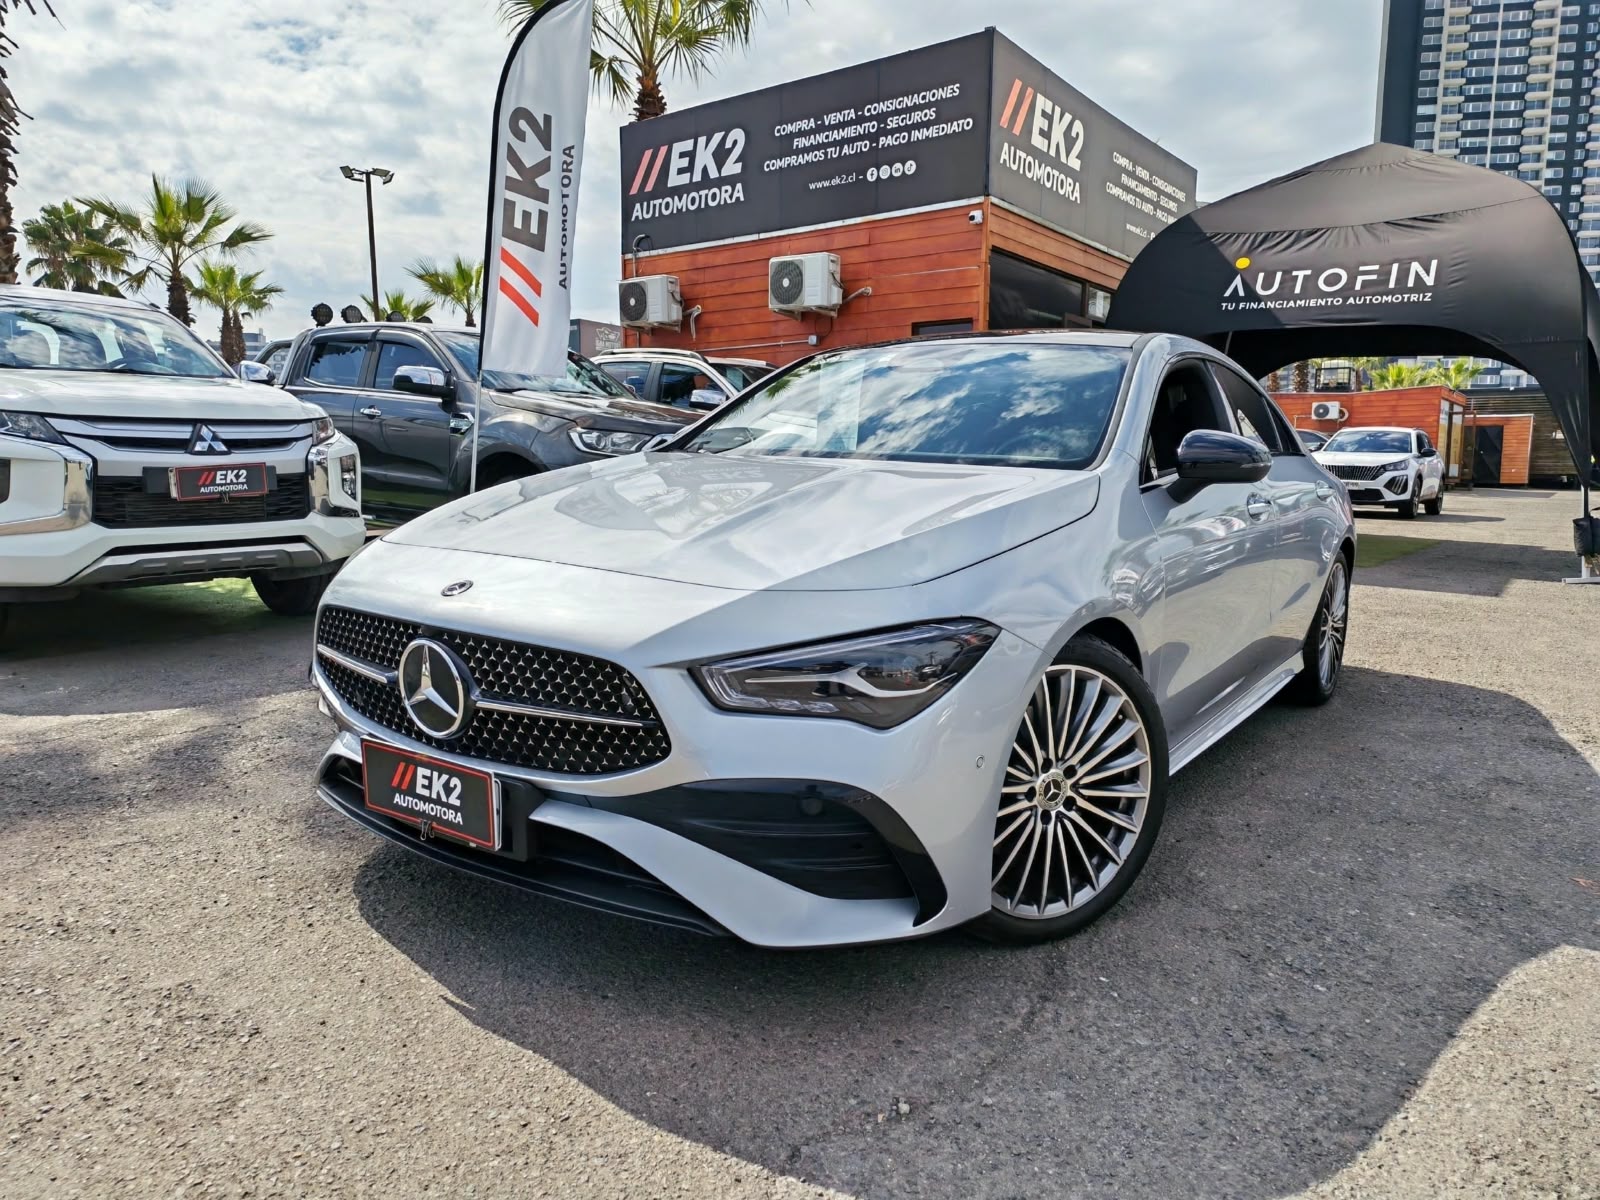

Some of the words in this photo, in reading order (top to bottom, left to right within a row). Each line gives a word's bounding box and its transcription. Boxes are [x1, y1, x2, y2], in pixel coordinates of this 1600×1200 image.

[774, 117, 816, 137] COMPRA
[824, 108, 856, 127] VENTA
[864, 83, 960, 117] CONSIGNACIONES
[793, 121, 878, 149] FINANCIAMIENTO
[886, 107, 937, 129] SEGUROS
[763, 149, 825, 172] COMPRAMOS
[826, 146, 840, 160] TU
[841, 140, 870, 157] AUTO
[878, 131, 909, 149] PAGO
[910, 117, 973, 142] INMEDIATO
[808, 172, 856, 190] www.ek2.cl
[1000, 142, 1081, 204] AUTOMOTORA
[1112, 151, 1133, 172] COMPRA
[1135, 164, 1150, 182] VENTA
[631, 182, 745, 221] AUTOMOTORA
[1106, 181, 1136, 206] COMPRAMOS
[1141, 201, 1154, 215] AUTO
[1121, 173, 1158, 202] FINANCIAMIENTO
[558, 144, 575, 290] AUTOMOTORA
[1223, 257, 1438, 297] AUTOFIN
[1220, 303, 1236, 311] TU
[1238, 297, 1343, 310] FINANCIAMIENTO
[1345, 292, 1433, 305] AUTOMOTRIZ
[199, 483, 248, 494] AUTOMOTORA
[393, 792, 463, 825] AUTOMOTORA
